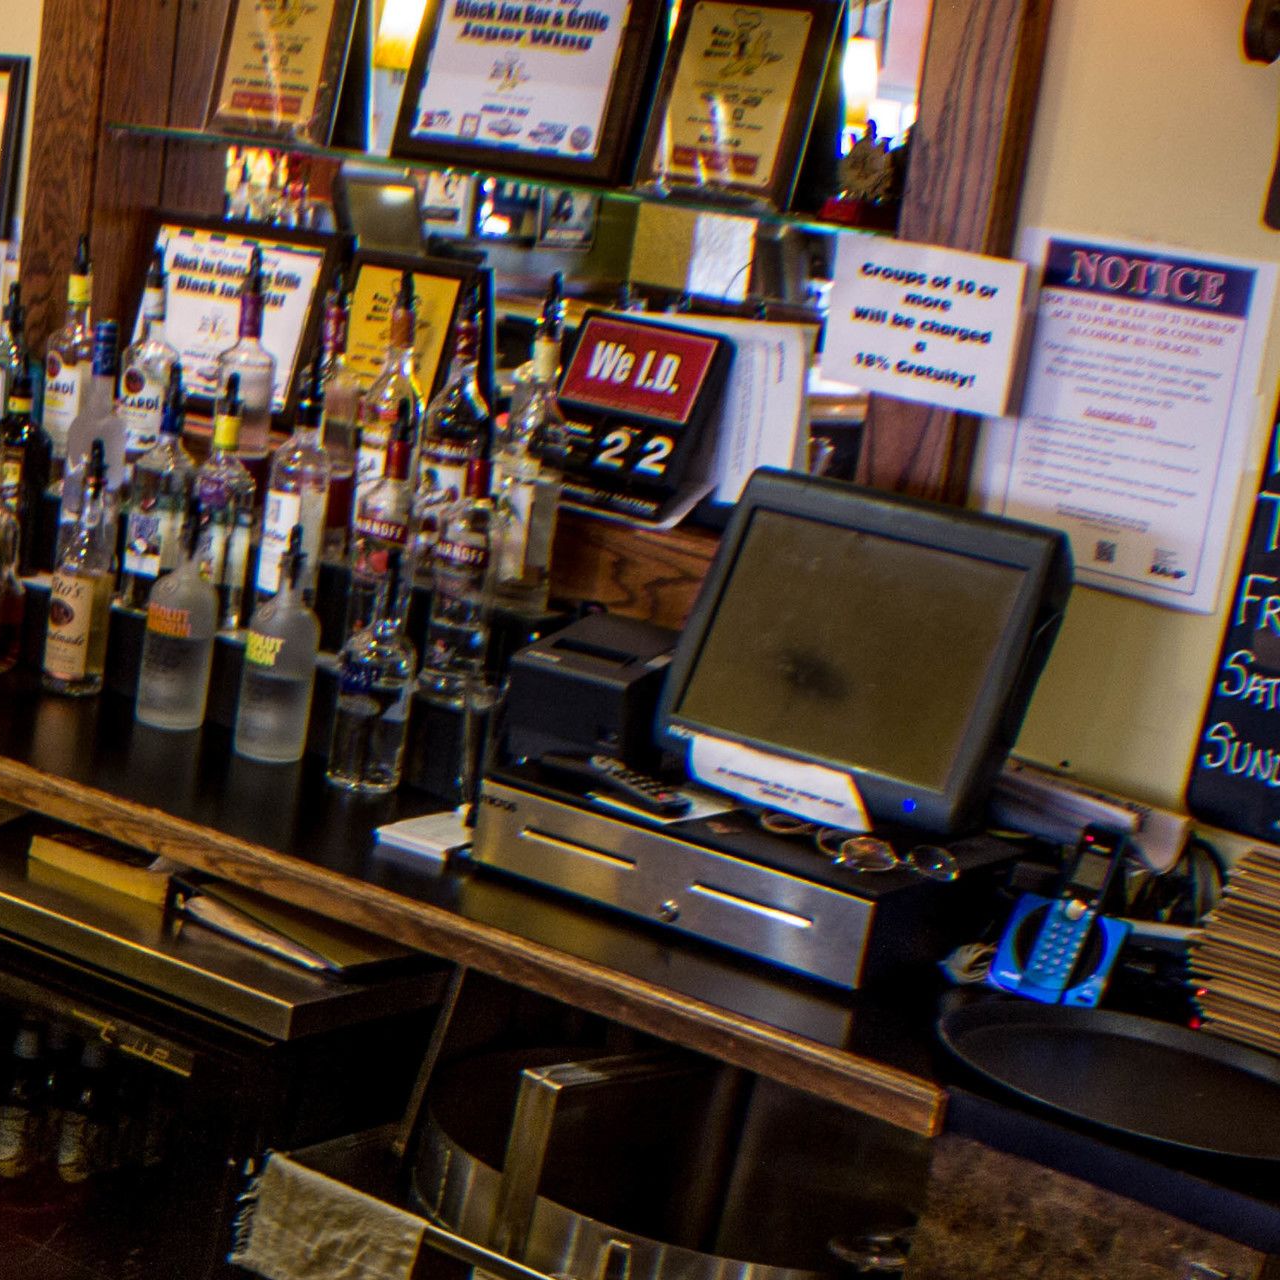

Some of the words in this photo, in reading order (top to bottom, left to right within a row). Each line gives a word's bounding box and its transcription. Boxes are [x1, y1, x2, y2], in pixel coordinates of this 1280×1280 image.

[453, 0, 497, 23] Black
[497, 2, 522, 24] Jax
[522, 4, 551, 27] Bar
[566, 9, 611, 32] Grille
[175, 275, 218, 295] Black
[859, 262, 928, 286] Groups
[930, 275, 952, 290] of
[954, 279, 976, 295] 10
[978, 286, 999, 299] or
[1066, 250, 1227, 307] NOTICE
[902, 292, 953, 312] more
[890, 312, 916, 330] be
[918, 319, 994, 346] charged
[912, 339, 928, 354] a
[587, 339, 637, 386] We
[633, 349, 682, 396] I.D.
[853, 351, 890, 372] 18%
[893, 359, 977, 389] Gratuity!
